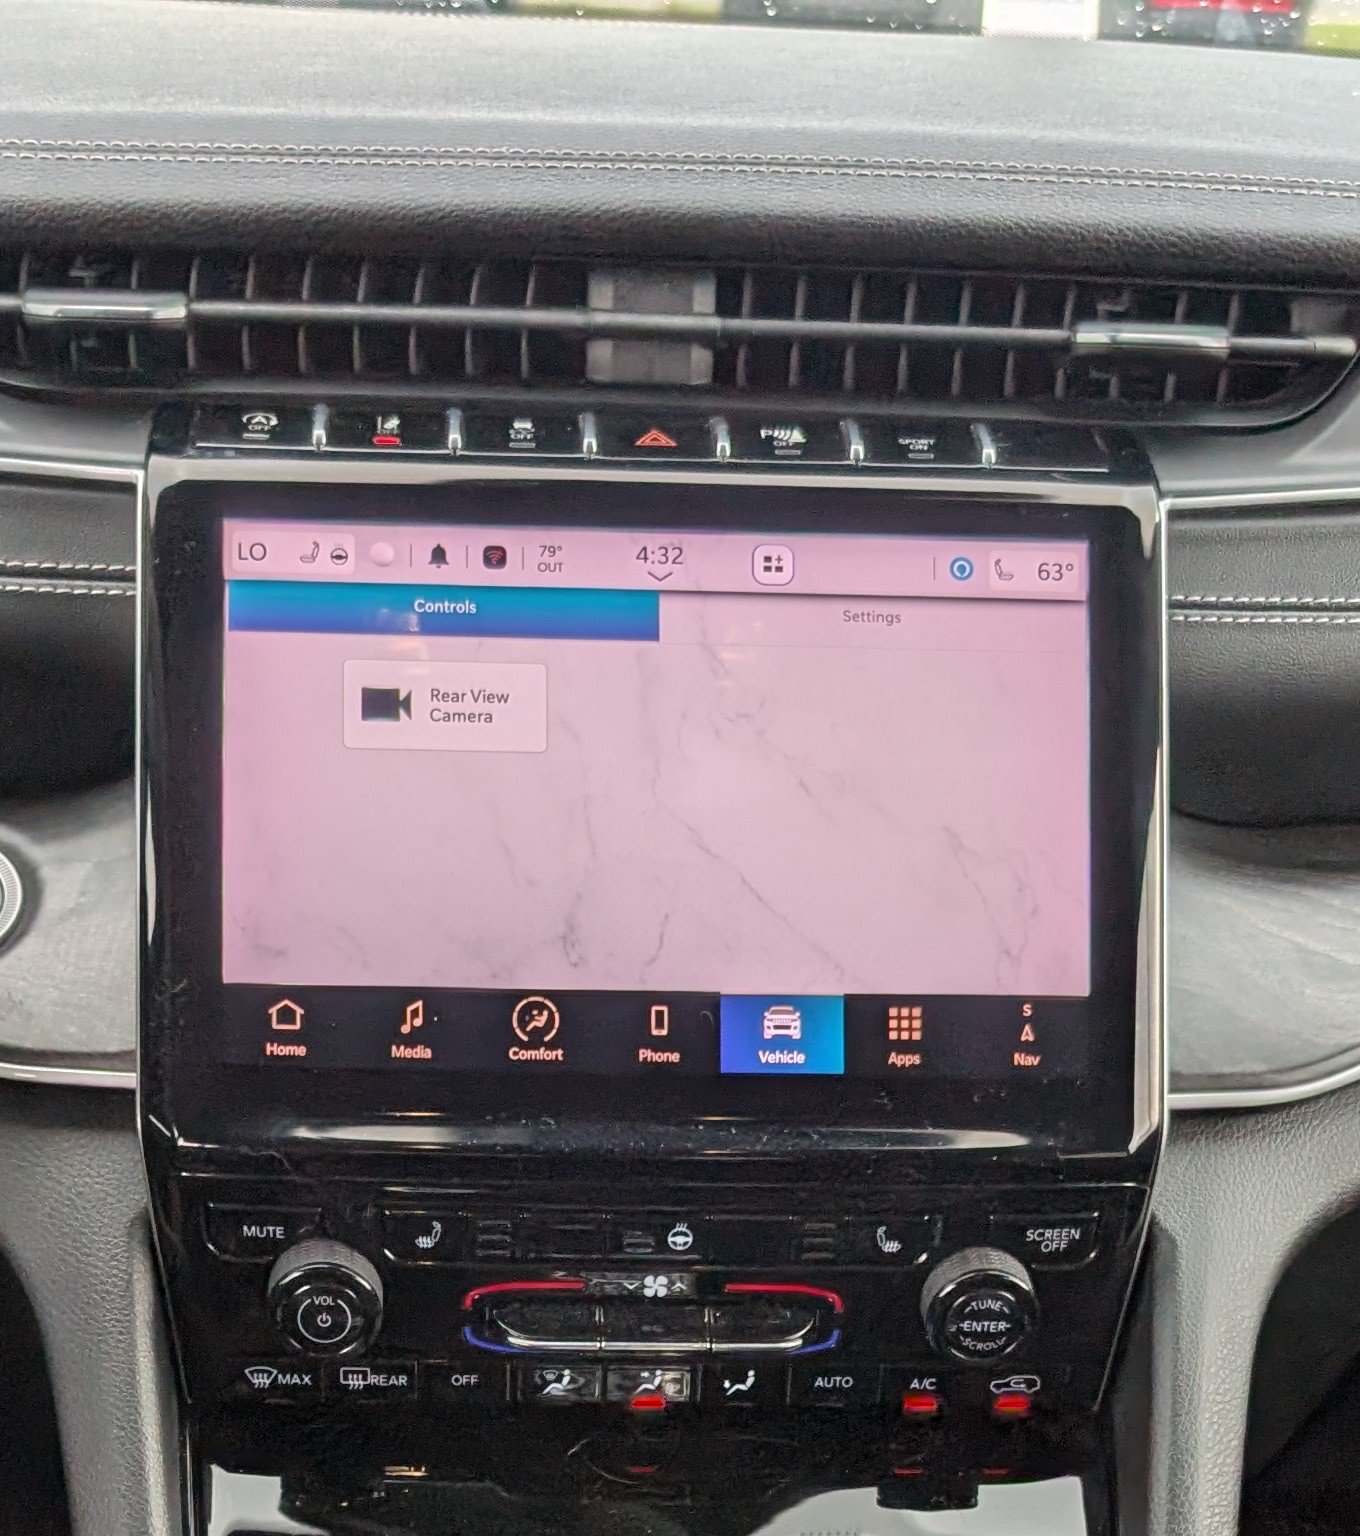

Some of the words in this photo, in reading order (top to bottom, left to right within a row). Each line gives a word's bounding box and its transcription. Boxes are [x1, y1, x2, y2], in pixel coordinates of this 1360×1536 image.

[897, 437, 935, 446] SPORT
[237, 542, 267, 561] LO
[538, 545, 563, 559] 79°
[635, 546, 684, 565] 4:32
[537, 562, 564, 573] OUT
[1037, 561, 1074, 582] 63°
[413, 598, 477, 615] Controls
[842, 608, 902, 626] Settings
[430, 688, 467, 703] Rear
[470, 689, 510, 705] View
[430, 708, 493, 724] Camera
[266, 1043, 307, 1057] Home
[391, 1045, 432, 1060] Media
[508, 1047, 564, 1062] Comfort
[639, 1049, 681, 1064] Phone
[758, 1050, 806, 1065] Vehicle
[887, 1051, 922, 1067] Apps
[1013, 1052, 1041, 1067] Nav
[242, 1225, 286, 1240] MUTE
[1026, 1228, 1081, 1242] SCREEN
[1040, 1240, 1069, 1253] OFF
[313, 1296, 336, 1307] VOL
[971, 1299, 1003, 1312] TUNE
[963, 1320, 1006, 1333] ENTER
[278, 1374, 313, 1387] MAX
[370, 1374, 408, 1388] REAR
[451, 1374, 480, 1387] OFF
[814, 1375, 854, 1389] AUTO
[909, 1377, 937, 1391] A/C
